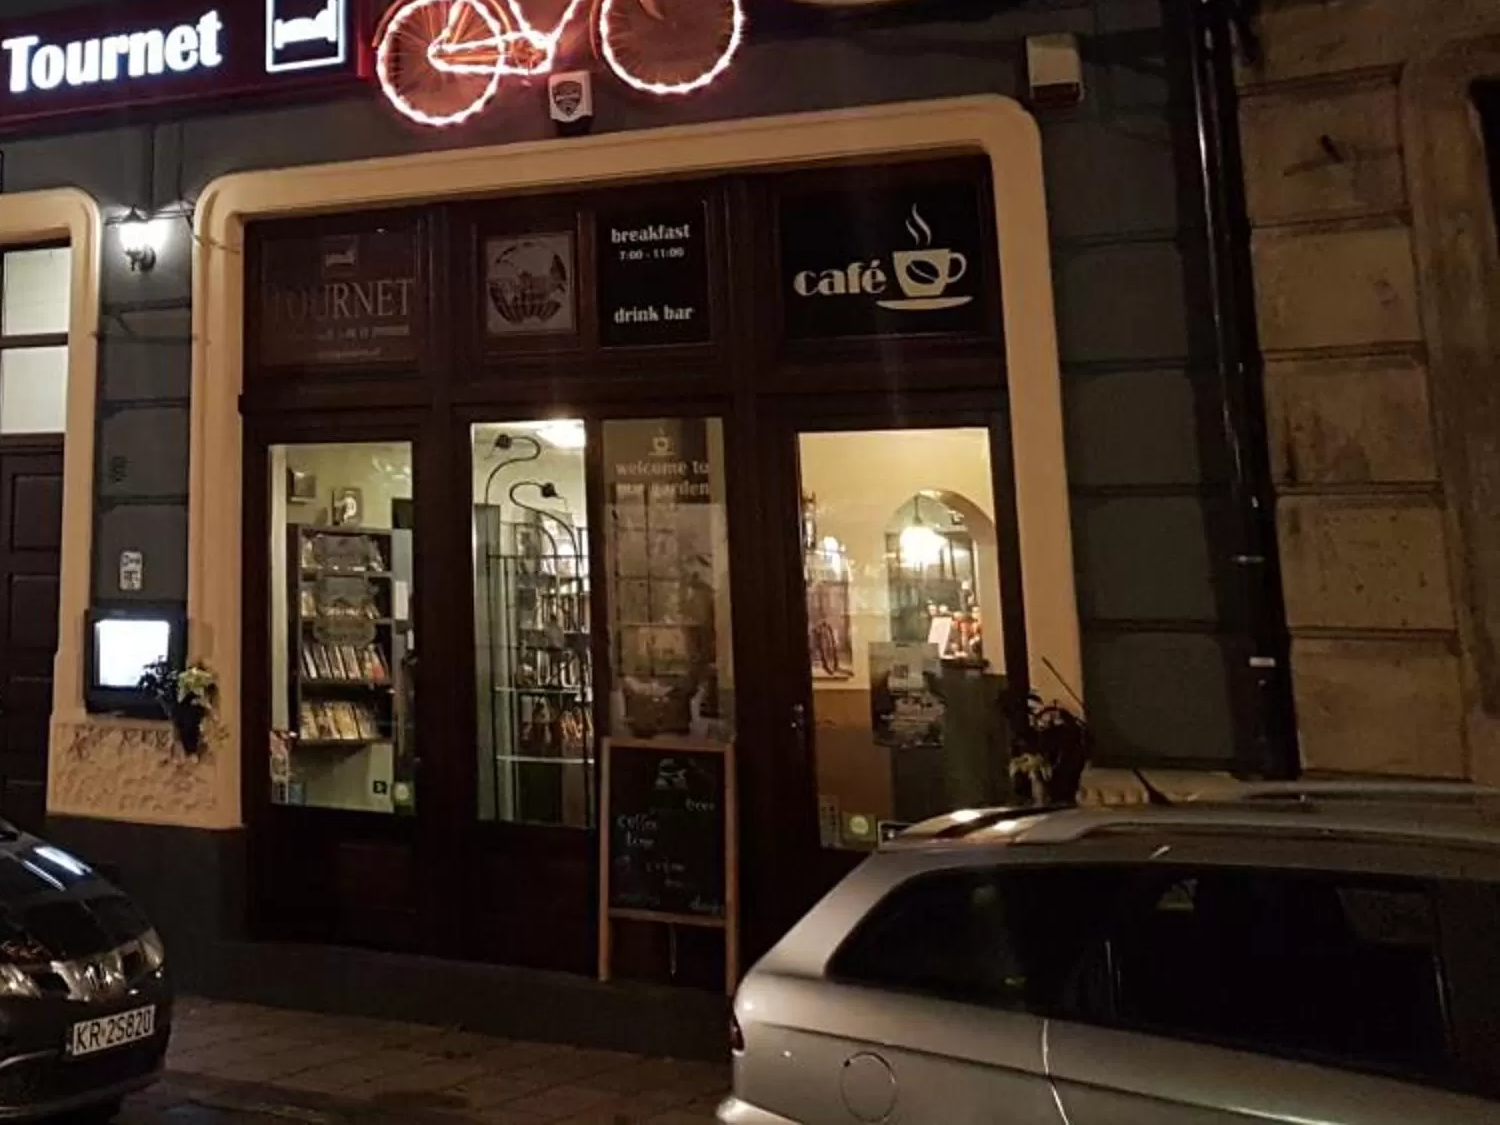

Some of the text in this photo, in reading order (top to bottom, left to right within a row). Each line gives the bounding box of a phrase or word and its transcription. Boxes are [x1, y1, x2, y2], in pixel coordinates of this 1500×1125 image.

[2, 9, 223, 94] Tournet
[611, 224, 690, 244] breakfast
[793, 259, 886, 298] café
[614, 304, 694, 324] drink bar
[76, 1021, 101, 1052] KR
